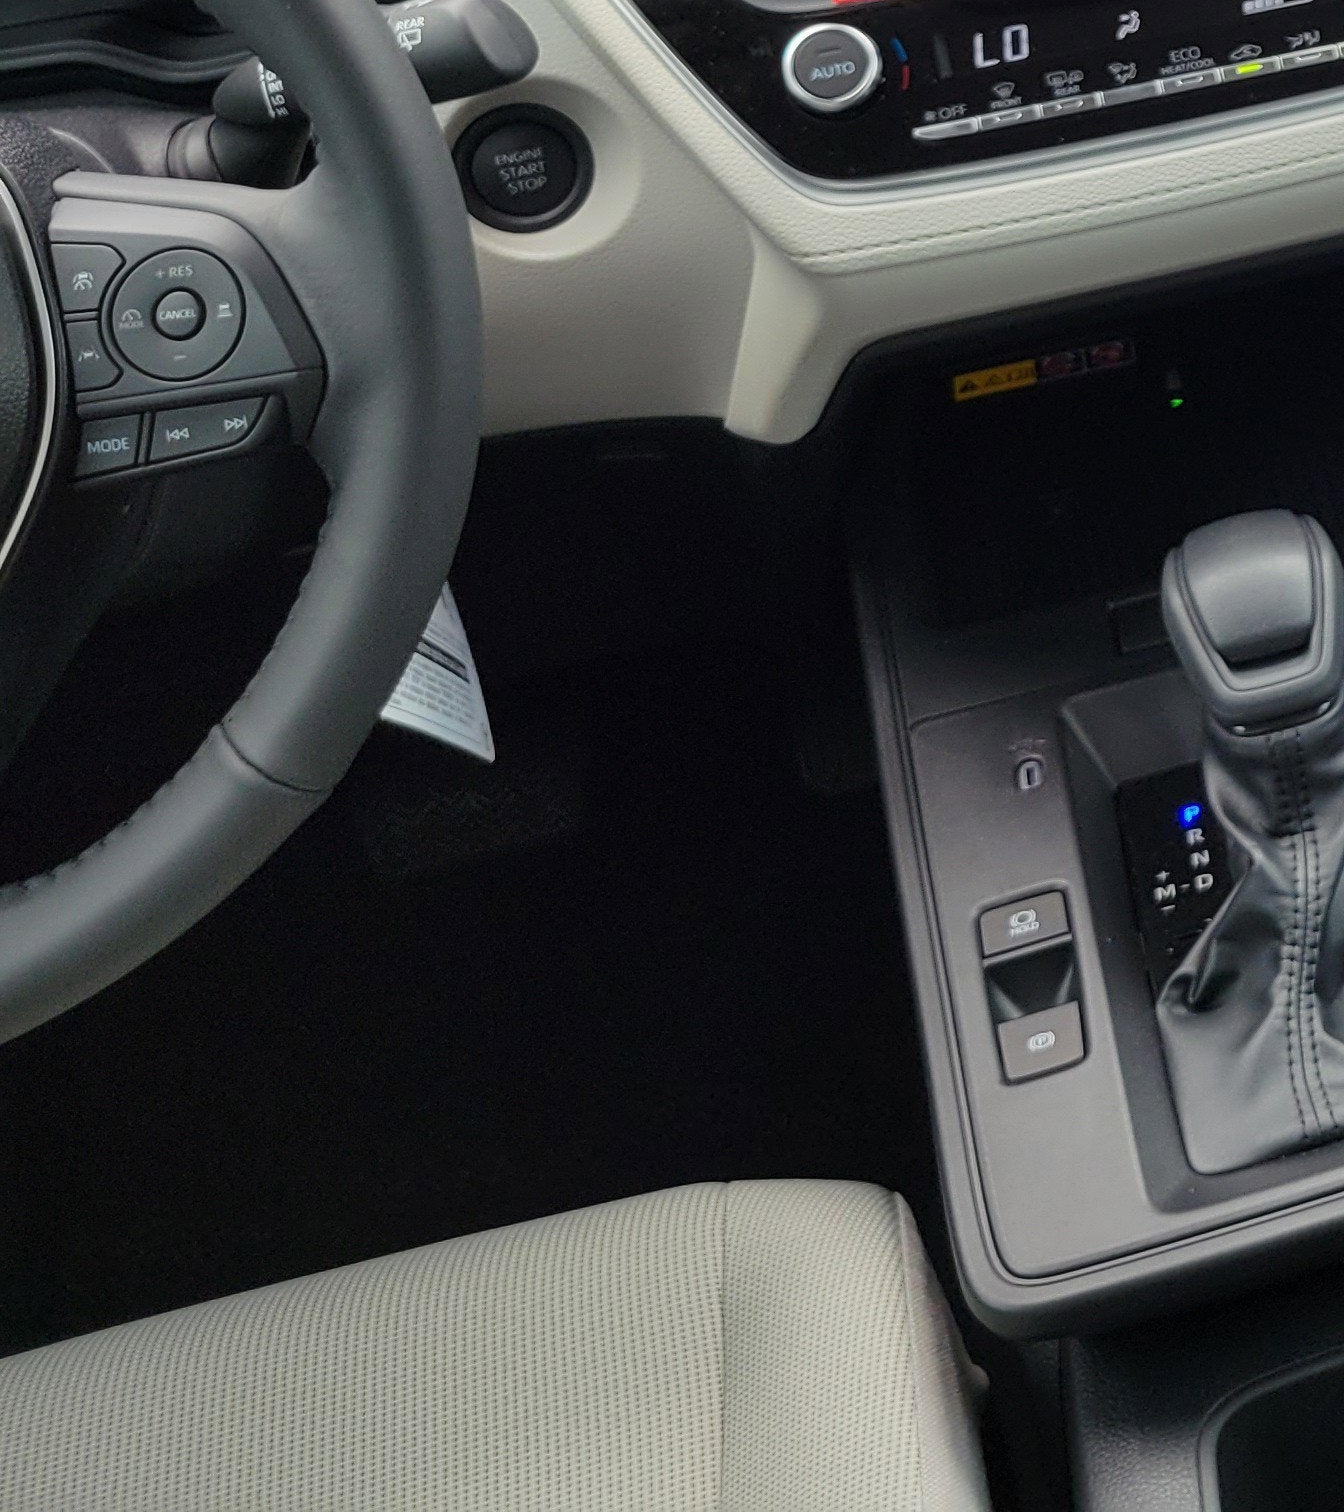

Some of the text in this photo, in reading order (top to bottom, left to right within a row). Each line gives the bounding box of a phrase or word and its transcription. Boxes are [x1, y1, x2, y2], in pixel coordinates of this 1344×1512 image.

[395, 16, 425, 31] REAR
[1169, 45, 1202, 63] ECO
[810, 60, 856, 81] AUTO
[1160, 57, 1217, 76] HEAT/COOL
[937, 102, 969, 120] OFF
[500, 161, 545, 180] START
[507, 176, 547, 195] STOP
[169, 264, 194, 278] RES
[159, 307, 197, 321] CANCEL
[87, 437, 130, 455] MODE
[1186, 828, 1206, 846] R
[1189, 849, 1210, 868] N
[1194, 873, 1214, 892] D
[1153, 883, 1176, 901] M
